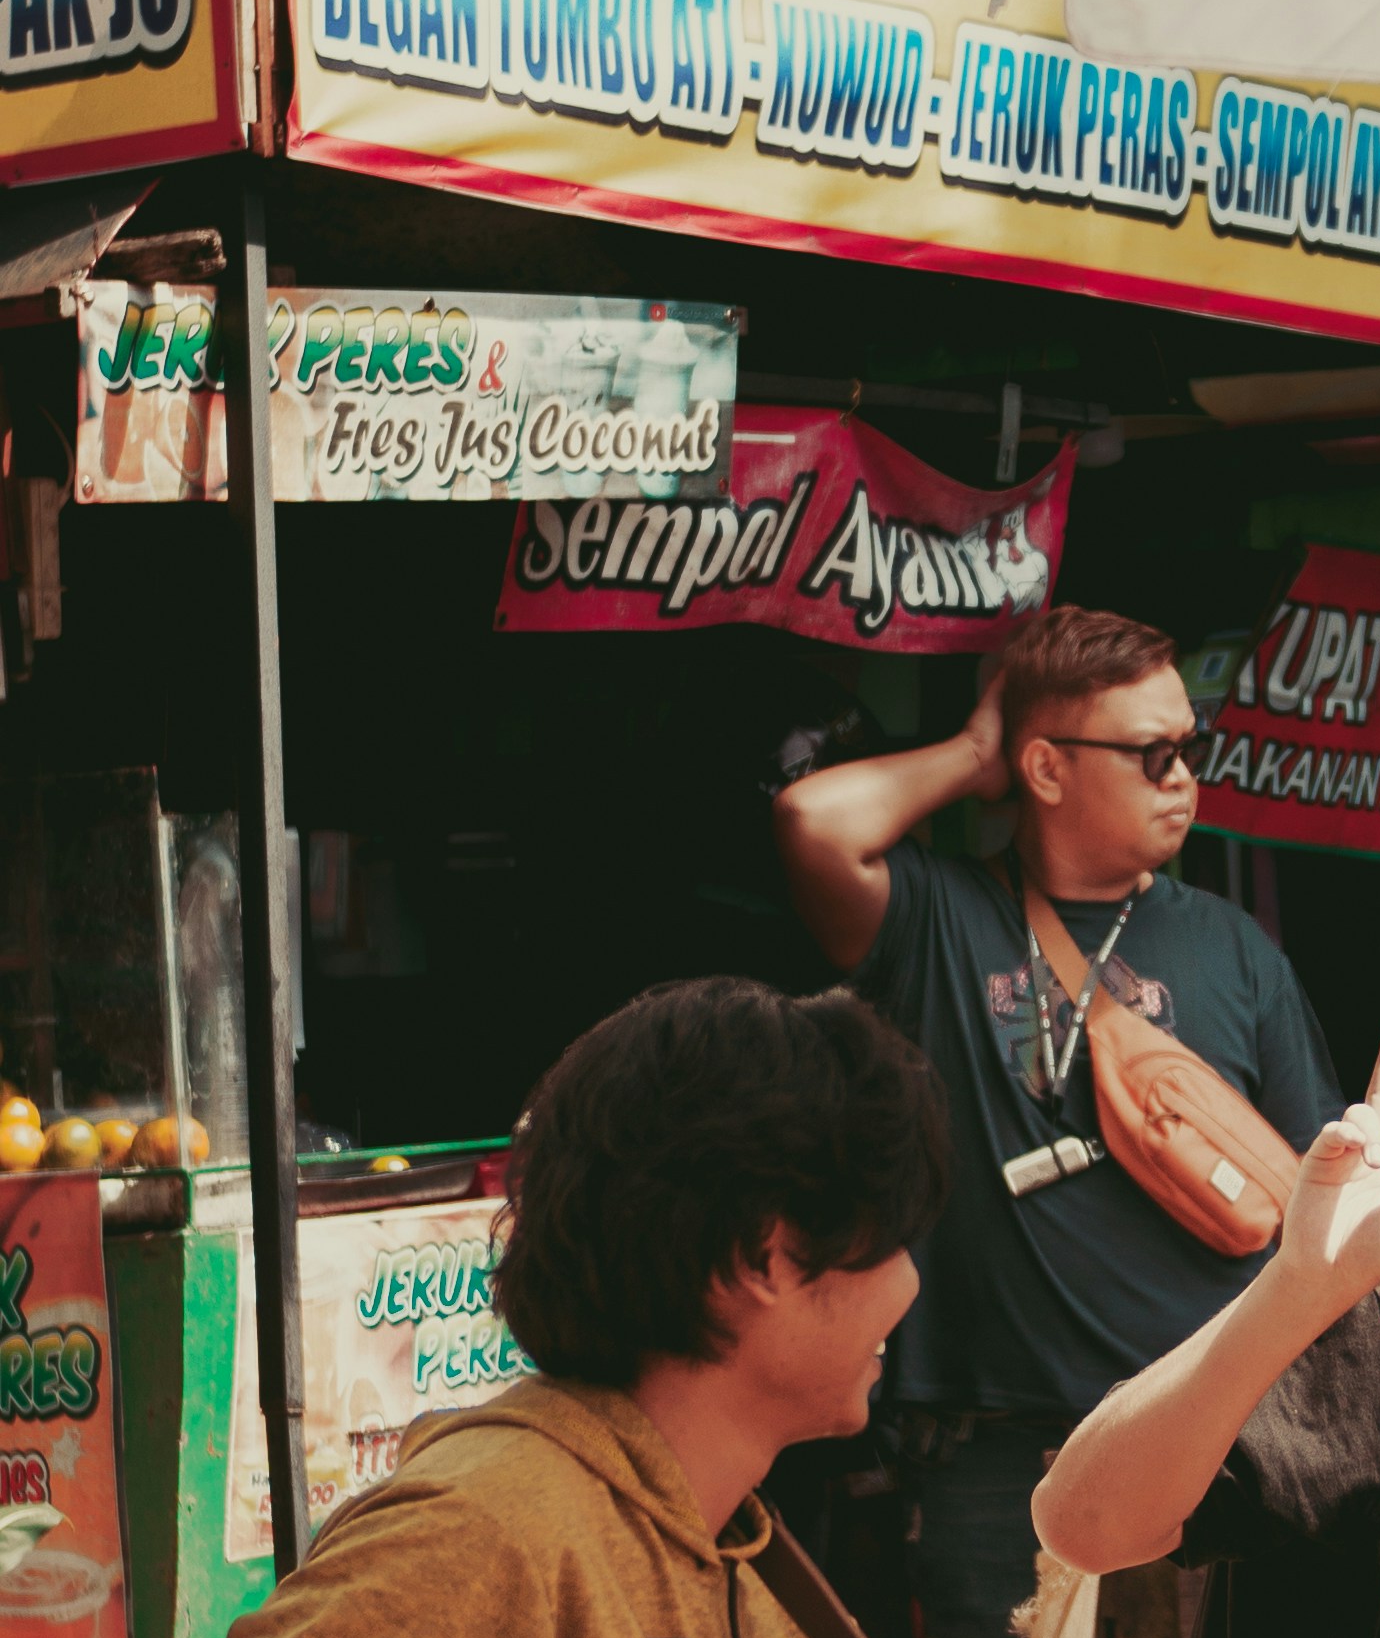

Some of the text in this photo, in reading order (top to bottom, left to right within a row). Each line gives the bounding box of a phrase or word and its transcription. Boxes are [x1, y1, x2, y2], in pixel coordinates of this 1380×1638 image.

[950, 40, 1071, 179] JERUK
[1074, 62, 1190, 202] PERAS
[1214, 90, 1344, 231] SEMPOL
[98, 302, 507, 393] JER PERES &
[436, 401, 512, 475] Jus
[528, 401, 714, 462] Coconut
[811, 489, 1006, 629] Ayam
[0, 1331, 94, 1412] RES
